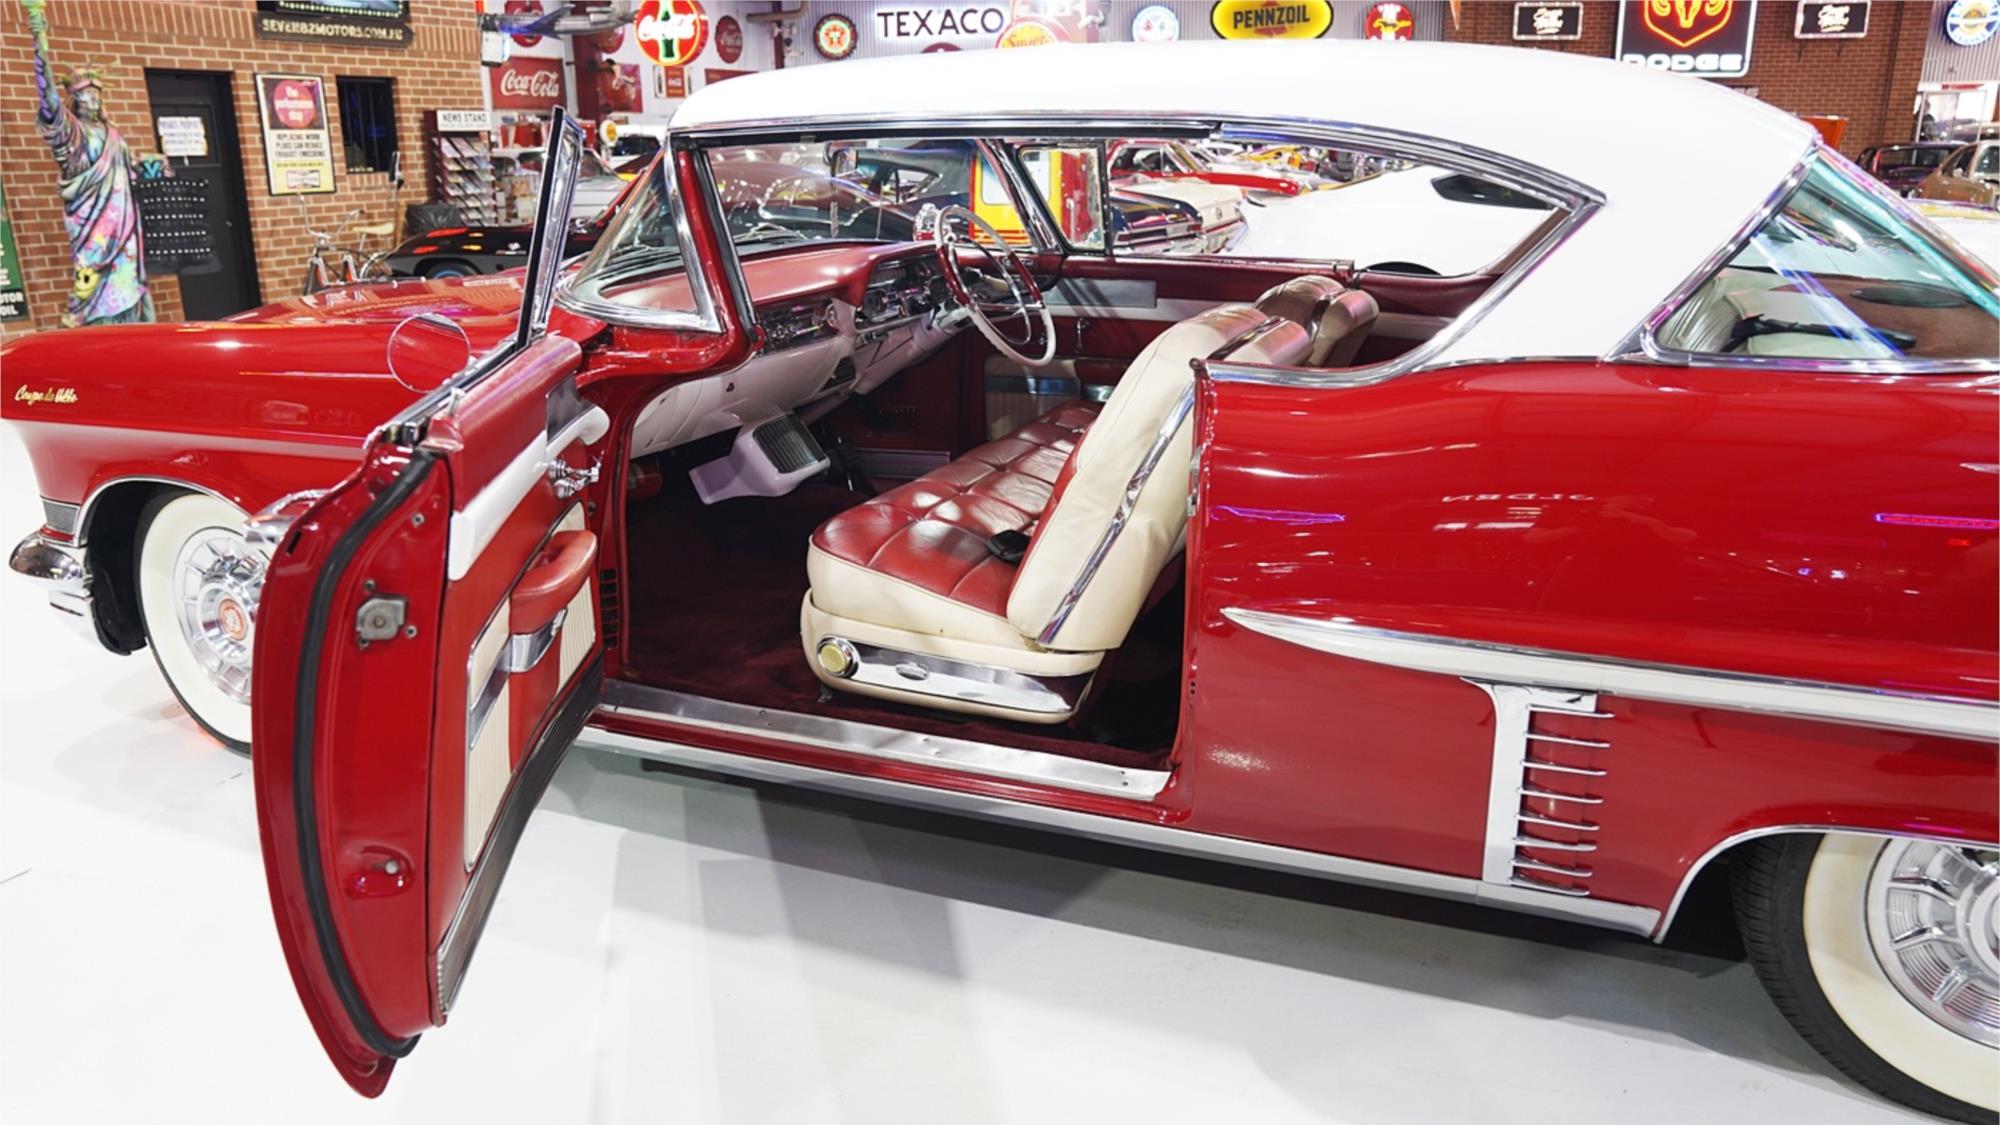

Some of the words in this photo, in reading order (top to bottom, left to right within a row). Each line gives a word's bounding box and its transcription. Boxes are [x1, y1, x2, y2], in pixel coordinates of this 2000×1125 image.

[876, 8, 1004, 38] TEXACO
[1233, 5, 1310, 29] PENNZOIL
[1623, 53, 1743, 72] DODGE
